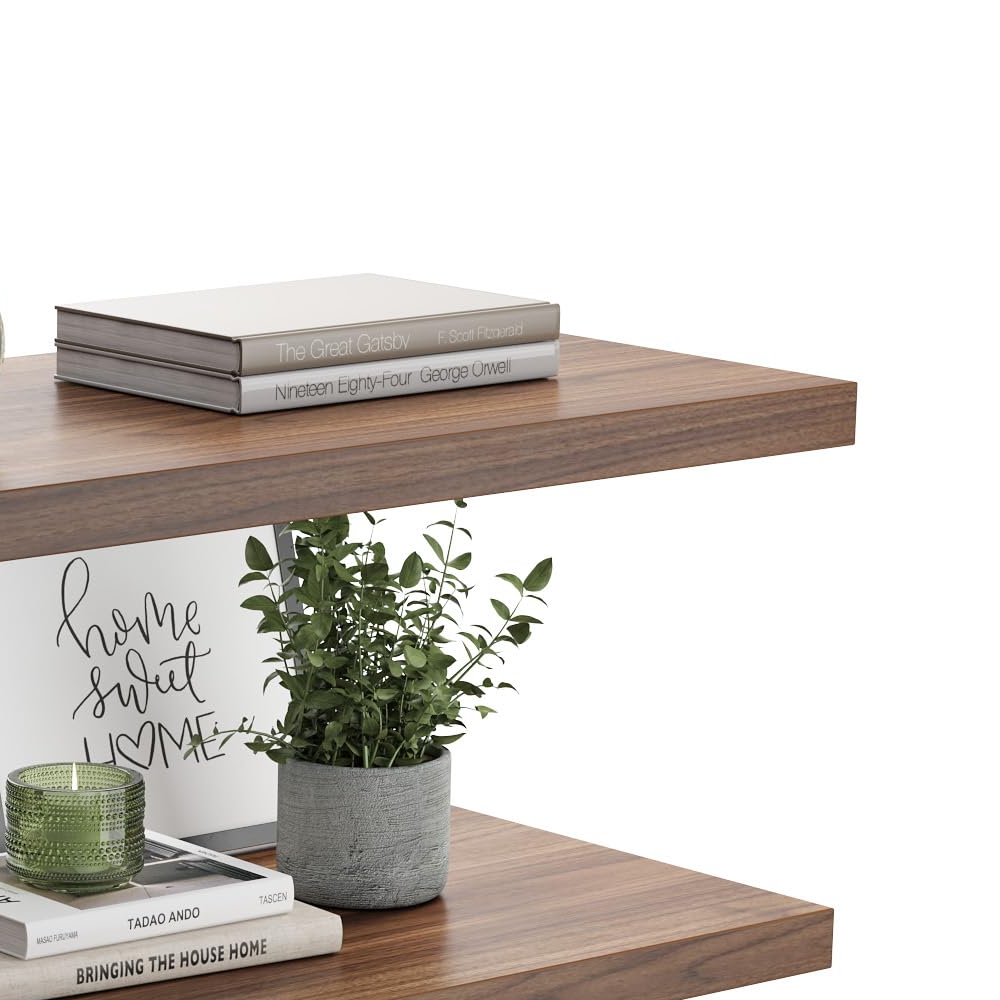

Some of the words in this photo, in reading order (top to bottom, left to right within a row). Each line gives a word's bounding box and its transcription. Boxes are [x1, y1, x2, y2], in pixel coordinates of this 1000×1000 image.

[448, 327, 474, 344] Scott
[477, 319, 524, 340] Fitzgerald
[275, 342, 306, 362] The
[310, 337, 352, 359] Great
[356, 331, 410, 354] Gatsby
[420, 366, 468, 383] George
[472, 357, 511, 377] Orwell
[275, 381, 333, 400] Nineteen
[338, 371, 413, 396] Eighty-Four
[56, 556, 201, 658] home
[72, 641, 212, 720] sweet
[258, 892, 288, 905] TASCEN
[128, 913, 166, 930] TADAO
[169, 907, 200, 923] ANDO
[76, 958, 144, 984] BRINGING
[148, 953, 175, 973] THE
[179, 945, 224, 968] HOUSE
[229, 938, 267, 960] HOME
